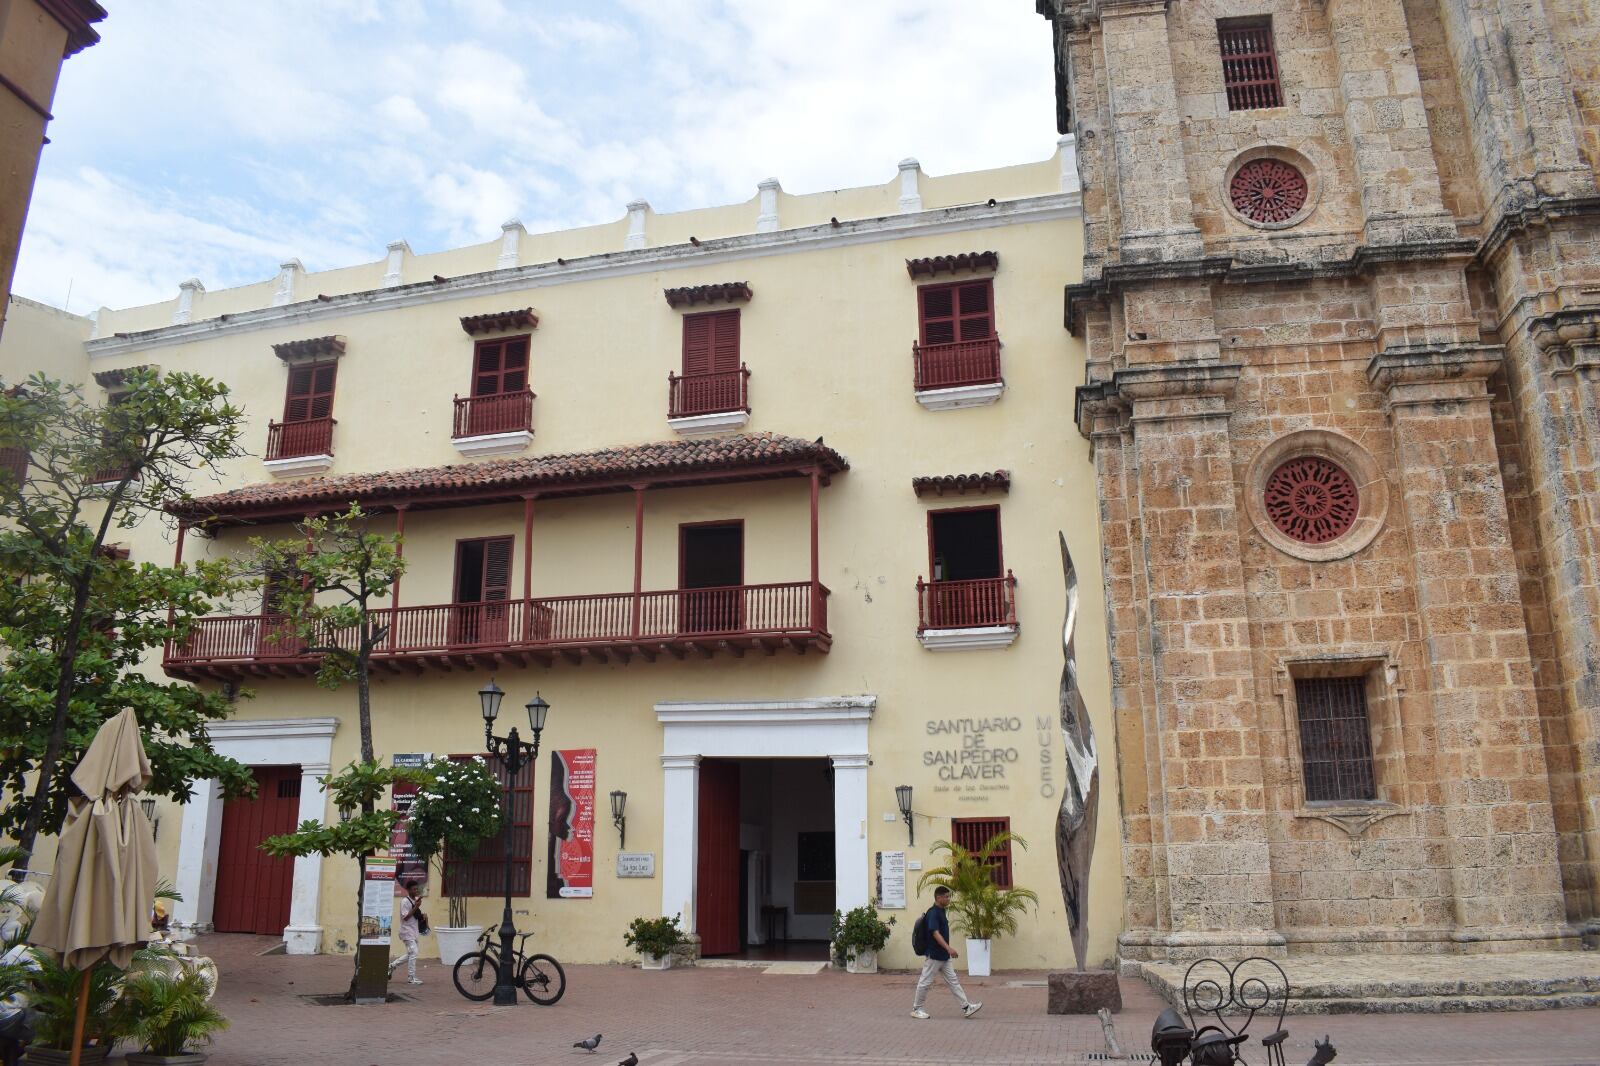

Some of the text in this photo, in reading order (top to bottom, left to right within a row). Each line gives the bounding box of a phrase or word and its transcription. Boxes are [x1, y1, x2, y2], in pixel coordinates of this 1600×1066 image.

[926, 716, 1021, 735] SANTUARIO
[962, 733, 985, 749] DE
[923, 747, 1018, 767] SAN PEDRO
[1035, 715, 1055, 798] MUSEO
[938, 763, 1005, 780] CLAVER
